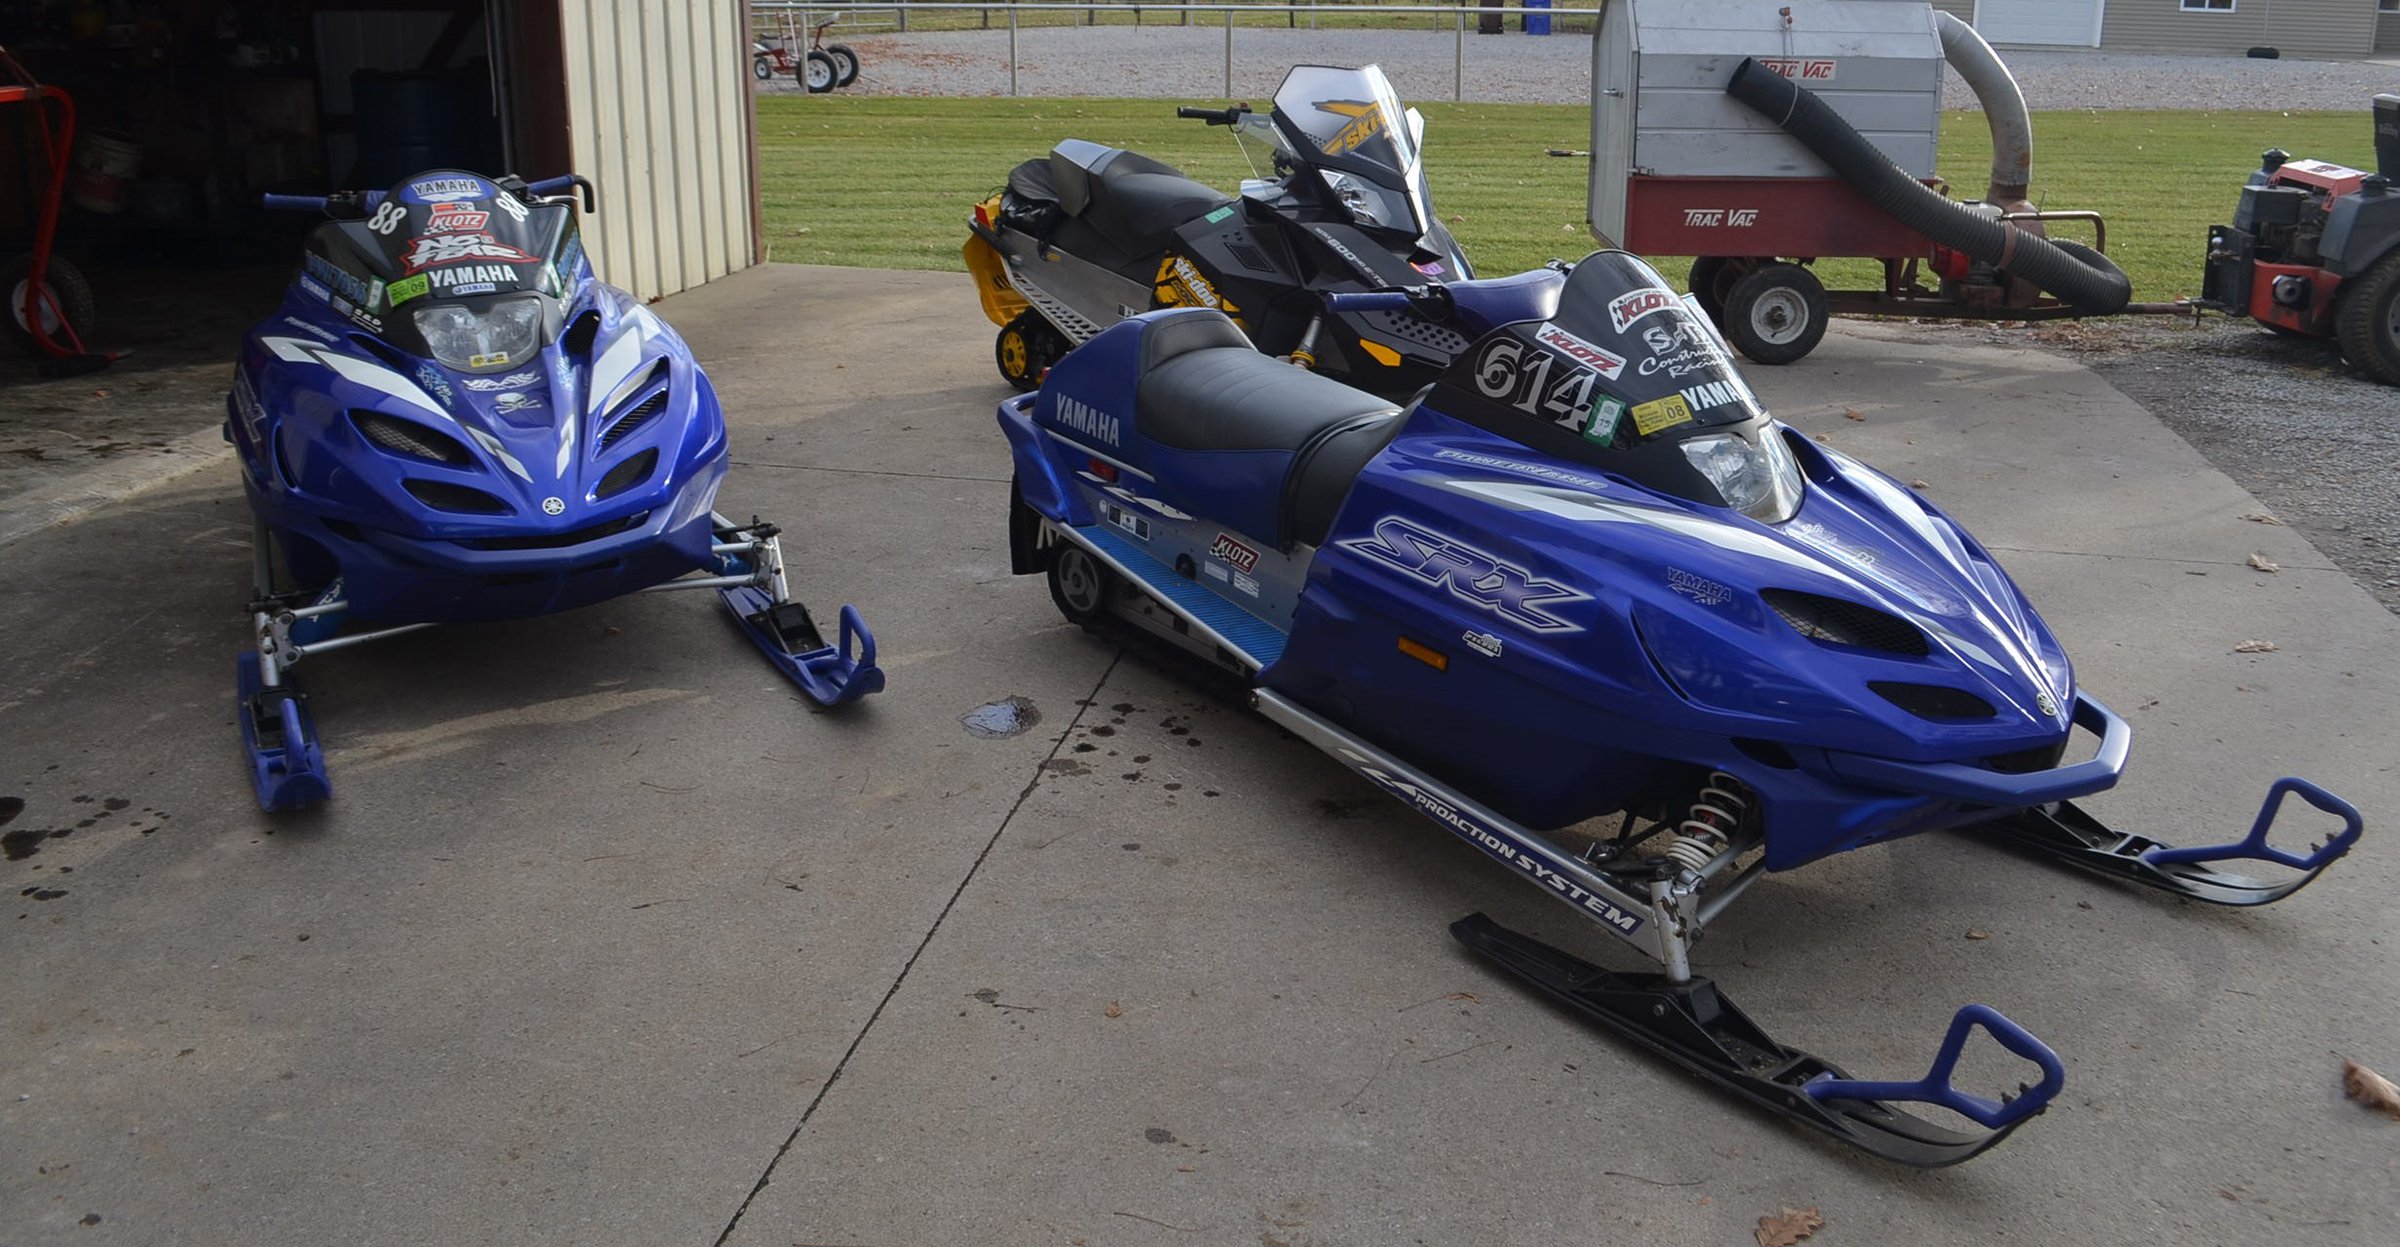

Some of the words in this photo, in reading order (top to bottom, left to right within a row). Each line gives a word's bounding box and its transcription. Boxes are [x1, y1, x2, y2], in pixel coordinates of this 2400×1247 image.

[1802, 61, 1835, 79] VAC
[411, 178, 482, 197] YAMAHA
[367, 201, 408, 235] 88
[434, 213, 483, 228] KLOTZ
[495, 190, 530, 223] 88
[1684, 209, 1725, 227] TRAC
[1727, 209, 1759, 227] VAC
[428, 264, 519, 288] YAMAHA
[1620, 293, 1682, 325] KLOT
[1544, 332, 1621, 372] KLOTZ
[1475, 336, 1597, 432] 614
[1057, 392, 1119, 448] YAMAHA
[1666, 405, 1687, 420] 08
[1216, 539, 1255, 568] KLOTZ
[1337, 516, 1594, 633] SRX
[1668, 566, 1732, 602] YAMAHA
[1414, 792, 1516, 860] PROACTION
[1516, 853, 1638, 931] SYSTEM
